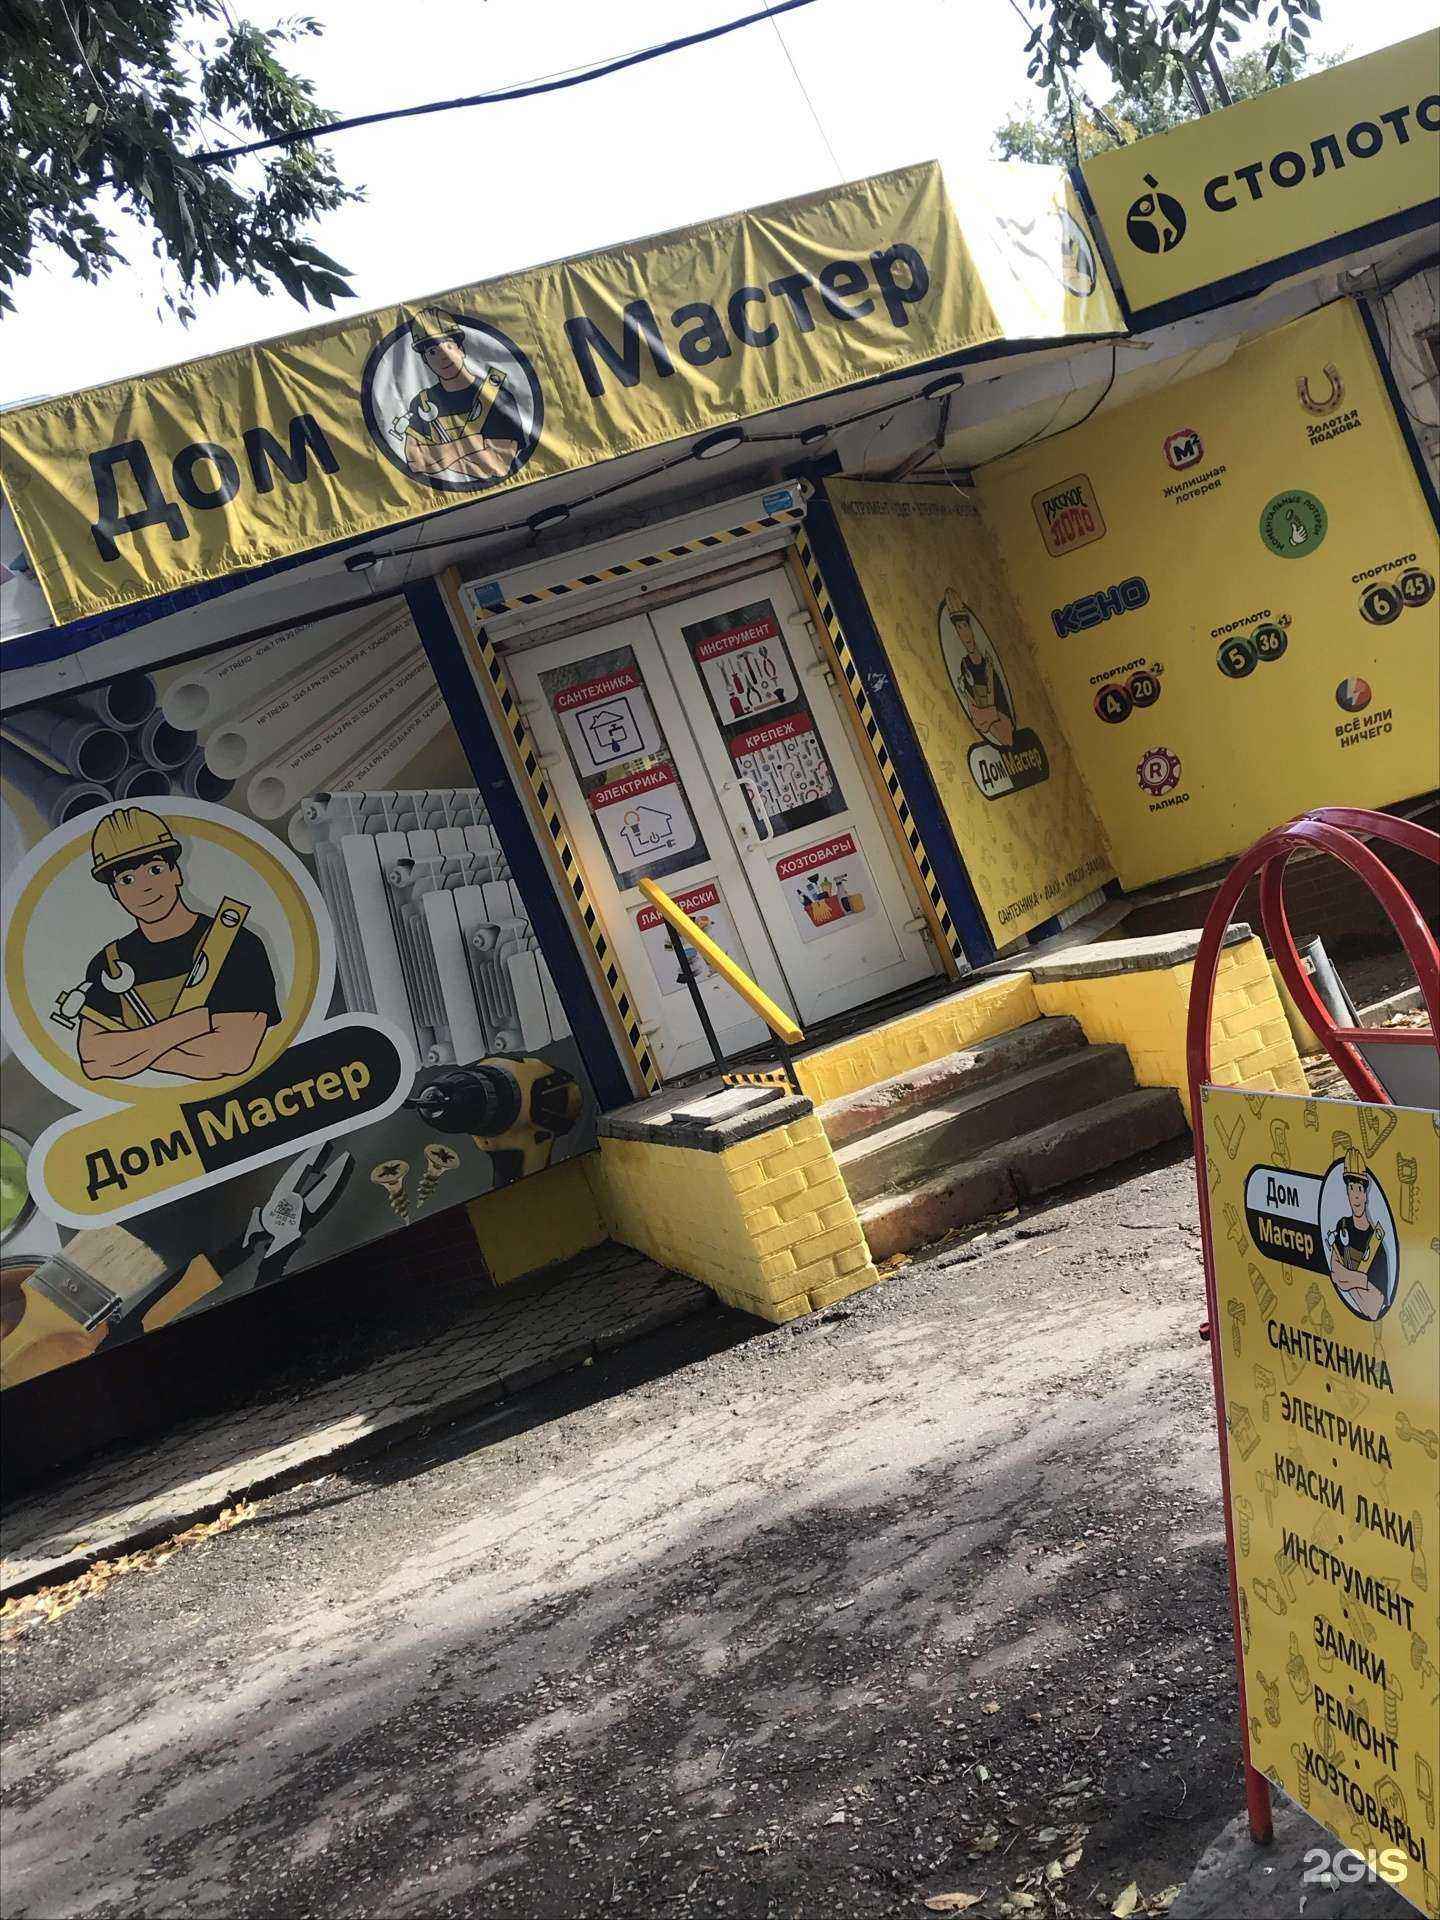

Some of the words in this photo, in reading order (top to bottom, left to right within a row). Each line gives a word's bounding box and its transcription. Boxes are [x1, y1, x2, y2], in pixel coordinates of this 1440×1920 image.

[1203, 94, 1440, 212] СТОЛОТО
[89, 414, 340, 562] Дом
[564, 243, 929, 398] Мастер
[1309, 419, 1362, 447] ПОДКОВА
[1163, 464, 1227, 498] Жилищная
[1176, 479, 1223, 505] лотерея
[1051, 507, 1095, 547] ЛОТО
[1351, 553, 1417, 584] СПОРТЛОТО
[1374, 594, 1390, 615] 6
[1405, 576, 1425, 596] 45
[699, 623, 770, 656] ИНСТРУМЕНТ
[1210, 609, 1272, 638] СПОРТЛОТО
[1228, 648, 1245, 669] 5
[1260, 632, 1279, 652] 36
[1090, 657, 1146, 684] СПОРТЛОТО
[557, 674, 634, 706] САНТЕХНИКА
[1106, 695, 1121, 716] 4
[1133, 680, 1153, 698] 20
[745, 721, 796, 749] КРЕПЕЖ
[1340, 722, 1393, 748] НИЧЕГО
[1363, 708, 1393, 728] ИЛИ
[595, 770, 668, 802] ЭЛЕКТРИКА
[1149, 762, 1163, 778] R
[1149, 793, 1189, 812] РАПИДО
[779, 839, 851, 876] ХОЗТОВАРЫ
[997, 892, 1041, 925] САНТЕХНИКА
[86, 1130, 192, 1201] Дом
[197, 1060, 371, 1147] Мастер
[1266, 1176, 1300, 1209] Дом
[1258, 1216, 1315, 1260] Мастер
[1267, 1319, 1394, 1395] САНТЕХНИКА
[1279, 1391, 1393, 1470] ЭЛЕКТРИКА
[1274, 1452, 1345, 1516] КРАСКИ
[1355, 1494, 1417, 1553] ЛАКИ
[1282, 1527, 1415, 1632] ИНСТРУМЕНТ
[1313, 1615, 1387, 1691] ЗАМКИ
[1313, 1684, 1399, 1773] РЕМОНТ
[1303, 1742, 1428, 1869] ХОЗТОВАРЫ
